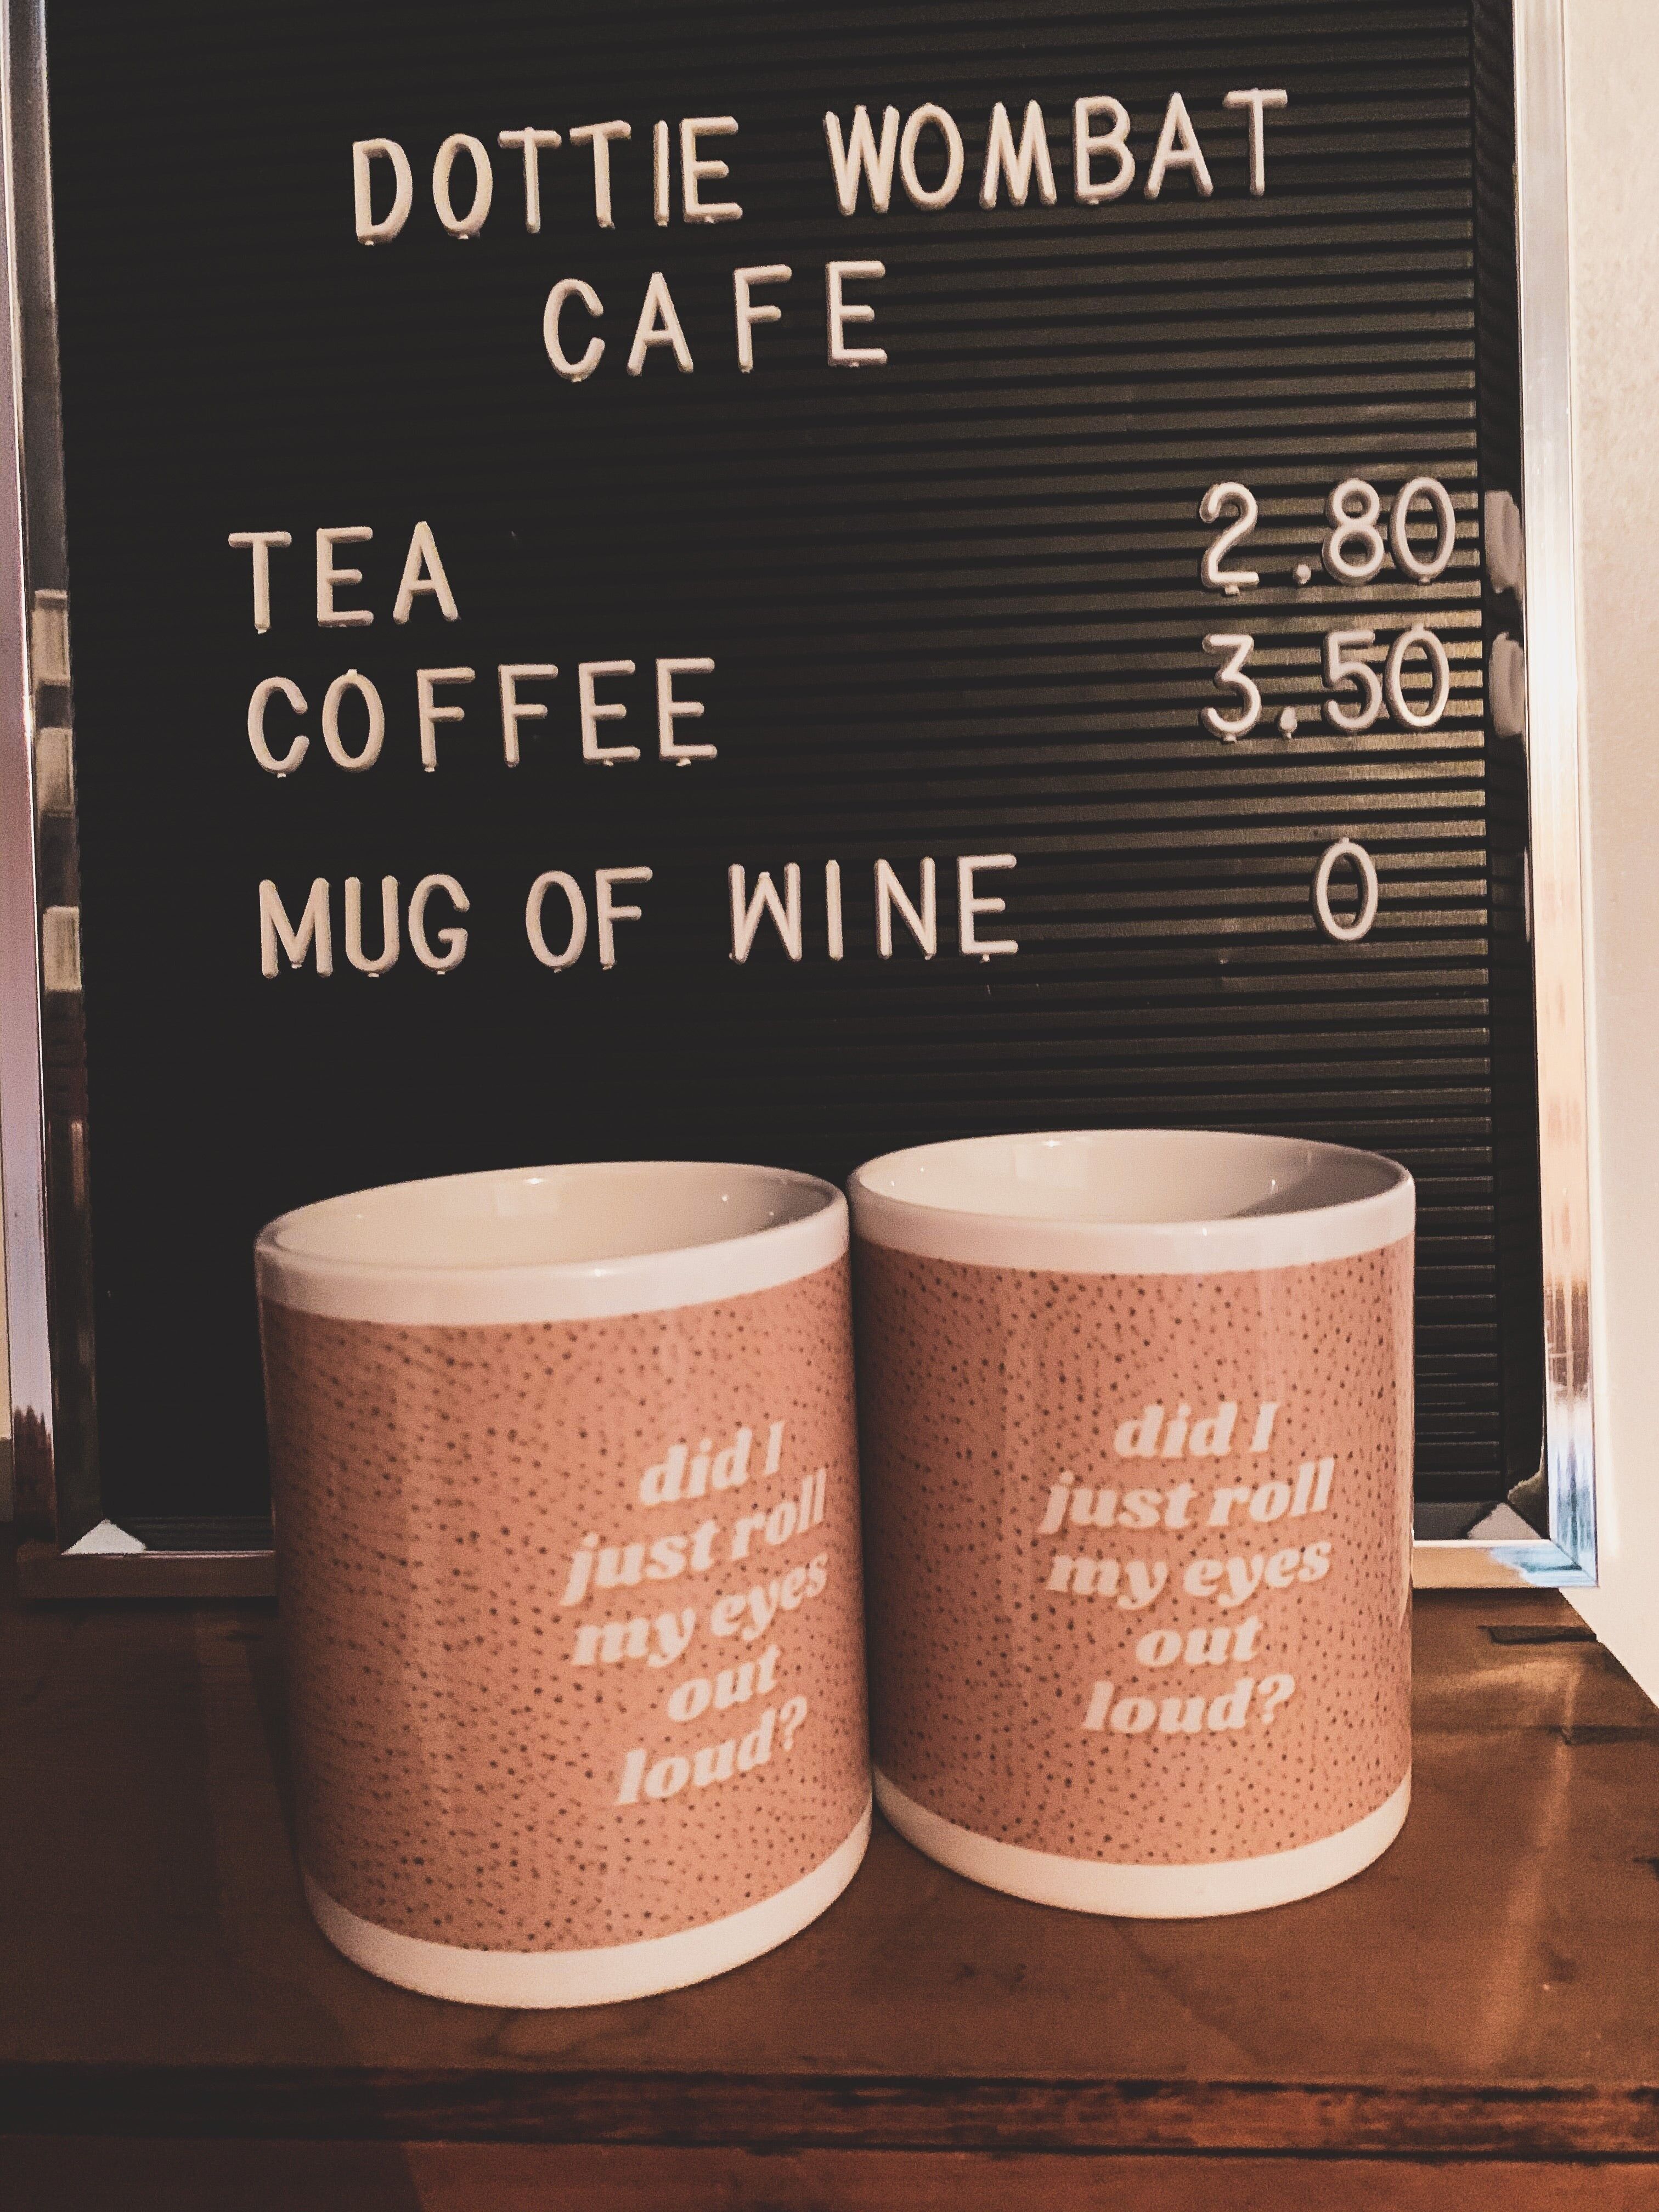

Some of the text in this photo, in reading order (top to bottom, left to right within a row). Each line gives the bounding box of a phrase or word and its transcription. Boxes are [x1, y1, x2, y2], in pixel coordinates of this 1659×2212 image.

[353, 88, 1288, 245] DOTTIE WOMBAT
[544, 261, 887, 382] CAFE
[228, 477, 1455, 634] TEA 2.80
[248, 624, 1449, 777] COFFEE 3.50
[259, 873, 470, 978] MUG
[526, 867, 652, 973] OF
[729, 854, 1018, 963] WINE
[640, 1421, 784, 1506] did I
[1114, 1401, 1279, 1458] did I
[560, 1469, 826, 1606] just roll
[1039, 1457, 1335, 1534] just roll
[571, 1554, 828, 1667] my eyes
[1047, 1541, 1332, 1610] my eyes
[668, 1645, 780, 1722] out
[1136, 1616, 1263, 1667] out
[616, 1697, 807, 1805] loud?
[1084, 1674, 1295, 1734] loud?
